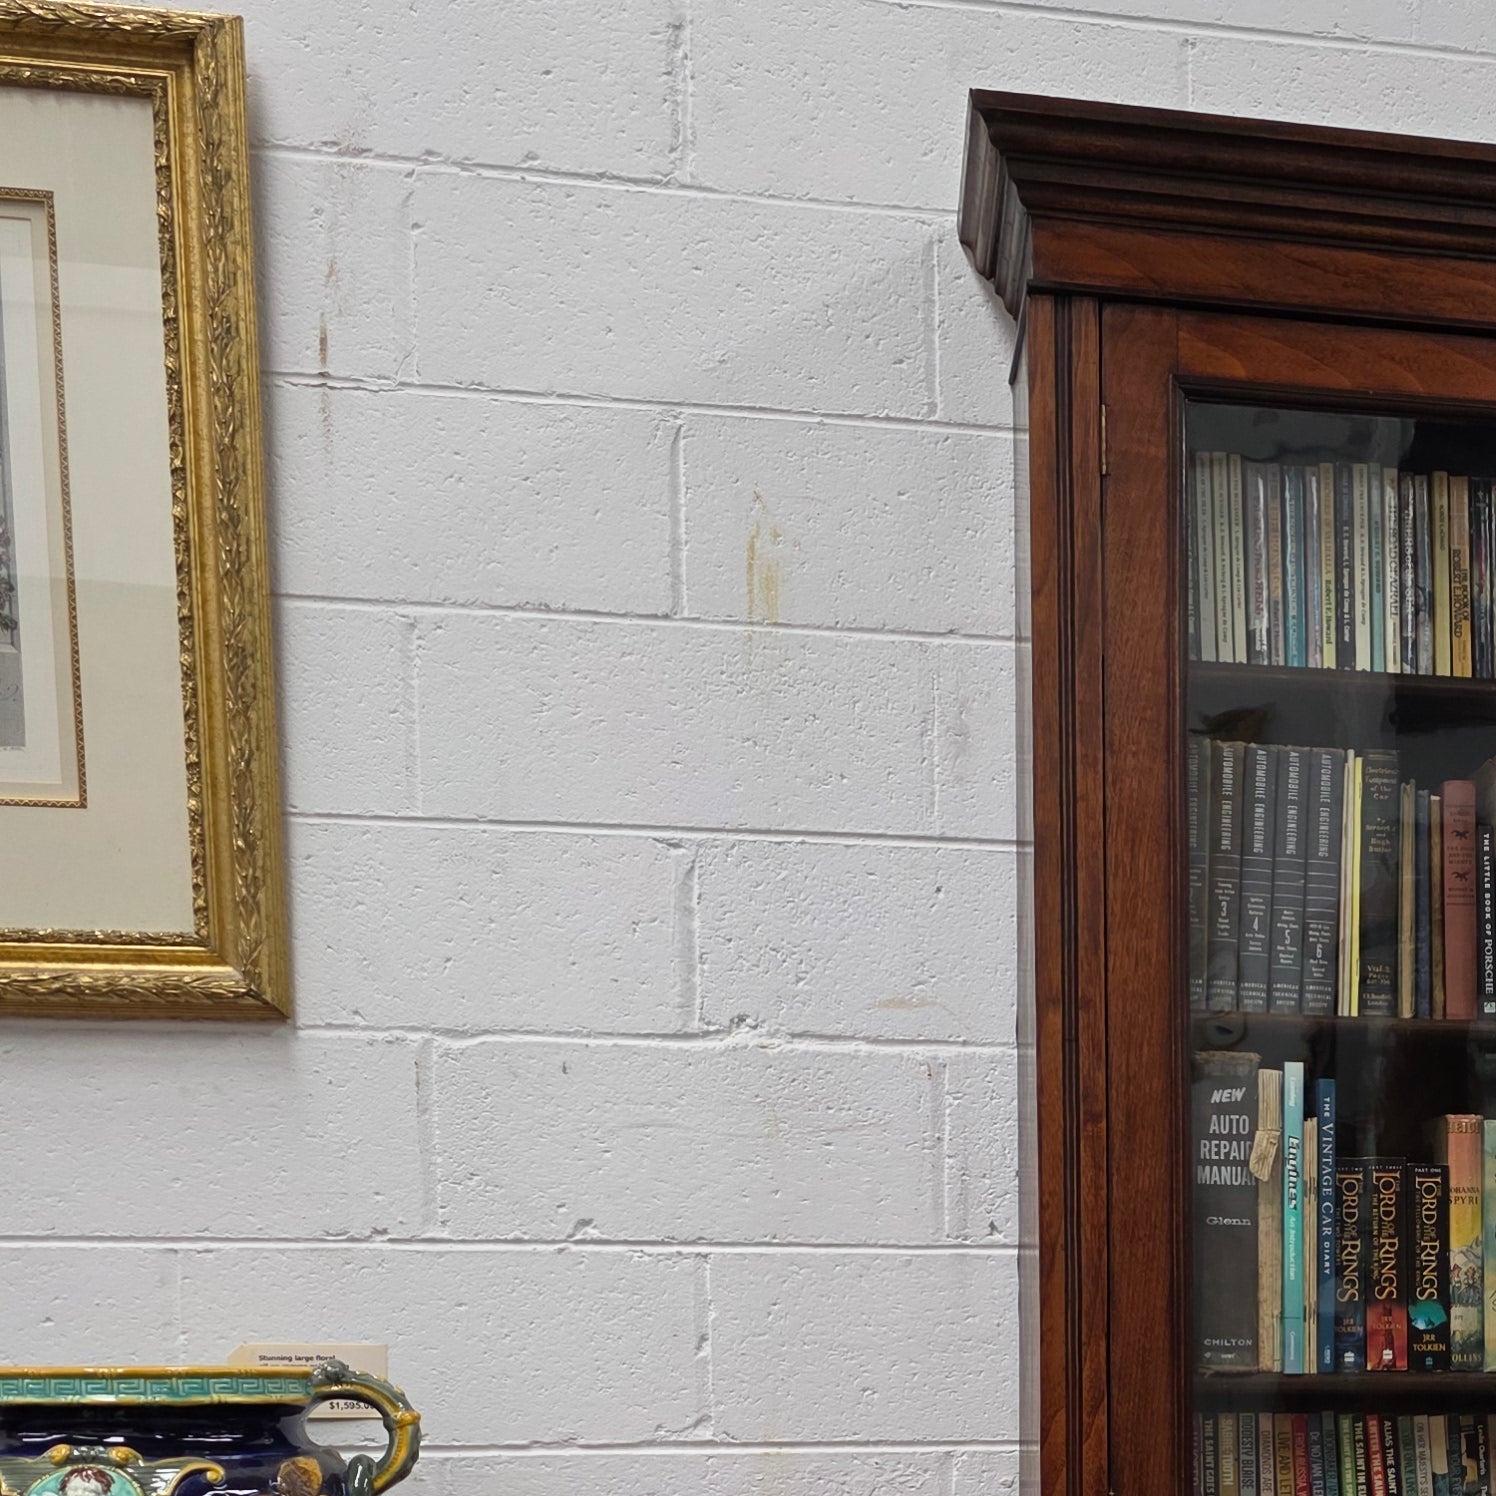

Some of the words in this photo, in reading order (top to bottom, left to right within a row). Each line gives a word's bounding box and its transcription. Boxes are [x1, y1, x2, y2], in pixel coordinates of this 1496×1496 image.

[1453, 549, 1461, 585] ROBERT
[1454, 596, 1462, 638] HOWARD
[1463, 612, 1469, 621] OF
[1221, 747, 1233, 796] AUTOMOBILE
[1255, 749, 1267, 798] AUTOMOBILE
[1287, 752, 1299, 801] AUTOMOBILE
[1320, 754, 1332, 803] AUTOMOBILE
[1220, 800, 1232, 851] ENGINEERING
[1253, 803, 1265, 853] ENGINEERING
[1286, 806, 1298, 855] ENGINEERING
[1318, 807, 1330, 857] ENGINEERING
[1221, 900, 1227, 916] 3
[1253, 916, 1259, 931] 4
[1485, 924, 1491, 936] OF
[1285, 929, 1291, 945] 5
[1315, 944, 1323, 958] 6
[1484, 939, 1494, 994] PORSCHE
[1211, 1087, 1246, 1104] NEW
[1323, 1096, 1331, 1118] THE
[1209, 1115, 1250, 1135] AUTO
[1321, 1123, 1333, 1197] VINTAGE
[1197, 1165, 1256, 1185] MANUA
[1286, 1135, 1300, 1209] Engines
[1336, 1172, 1362, 1223] LORD
[1372, 1170, 1400, 1223] LORD
[1415, 1175, 1441, 1223] LORD
[1206, 1217, 1251, 1226] Glenn
[1321, 1202, 1333, 1237] CAR
[1372, 1237, 1378, 1246] OF
[1323, 1241, 1331, 1275] DIARY
[1336, 1237, 1361, 1301] RINGS
[1373, 1238, 1397, 1300] RINGS
[1417, 1241, 1441, 1301] RINGS
[1204, 1338, 1252, 1346] CHILTON
[1413, 1344, 1446, 1352] TOLKIEN
[1423, 1334, 1436, 1342] JRR
[1205, 1420, 1213, 1436] THE
[1241, 1415, 1252, 1456] MODESTY
[1354, 1422, 1363, 1440] THE
[1384, 1421, 1394, 1447] ALIAS
[1261, 1430, 1272, 1474] DIAMONDS
[1277, 1432, 1290, 1452] LIVE
[1295, 1432, 1305, 1454] FROM
[1343, 1434, 1351, 1456] SAINT
[1417, 1436, 1425, 1449] HER
[1205, 1439, 1214, 1468] SAINT
[1355, 1442, 1365, 1472] SAINT
[1372, 1453, 1382, 1472] THE
[1386, 1448, 1395, 1465] THE
[1404, 1453, 1413, 1474] ONLY
[1242, 1460, 1254, 1489] BLAISE
[1279, 1455, 1291, 1475] AND
[1418, 1451, 1428, 1485] MAJESTY'S
[1206, 1469, 1214, 1493] GOES
[1262, 1479, 1272, 1492] ARE
[1281, 1480, 1292, 1495] LET
[1344, 1470, 1352, 1483] THE
[1357, 1474, 1366, 1482] IN
[1387, 1467, 1397, 1494] SAINT
[1405, 1477, 1415, 1494] LIVE
[1452, 1477, 1462, 1496] EYES
